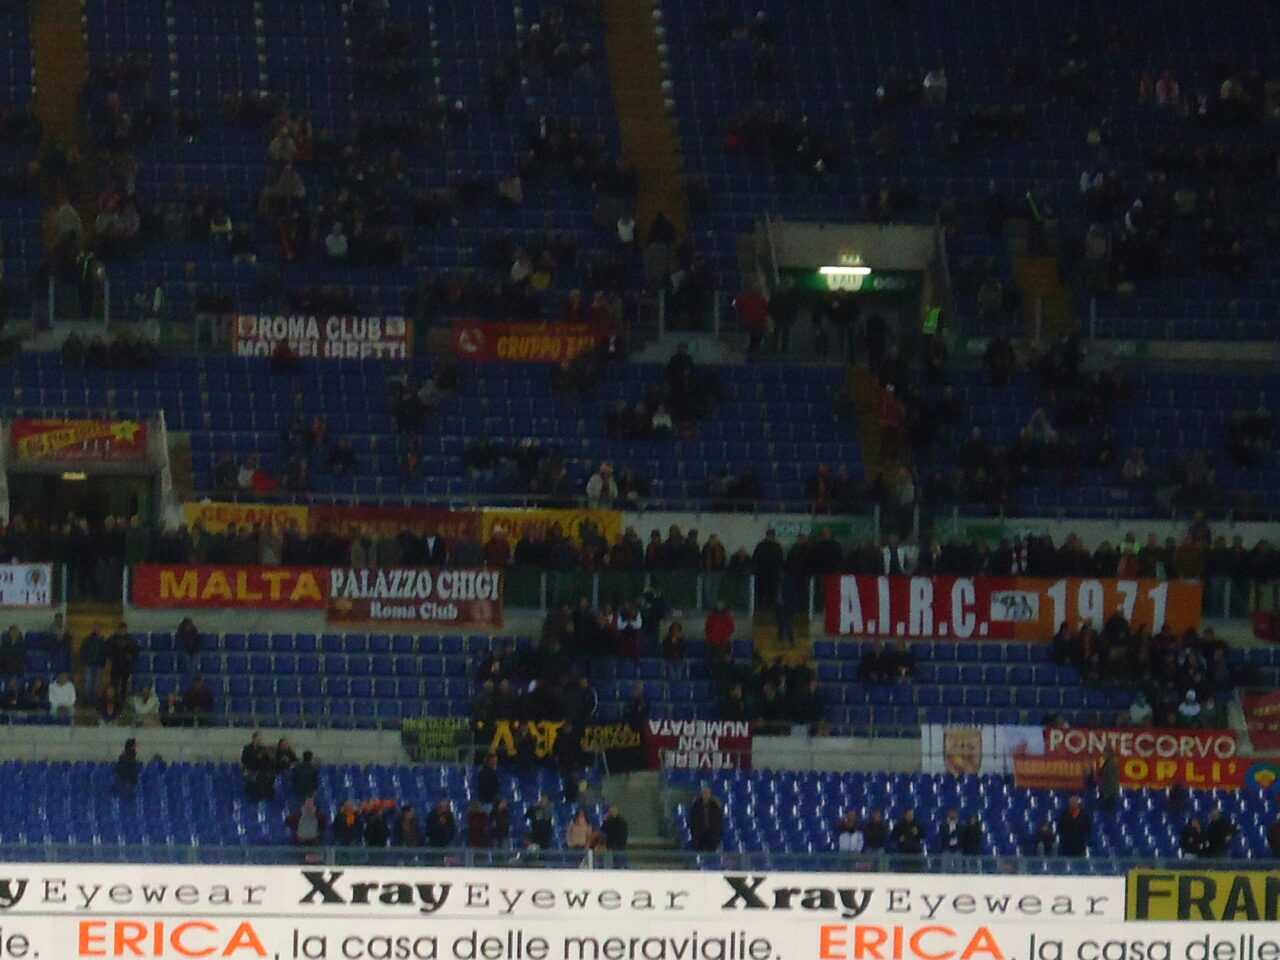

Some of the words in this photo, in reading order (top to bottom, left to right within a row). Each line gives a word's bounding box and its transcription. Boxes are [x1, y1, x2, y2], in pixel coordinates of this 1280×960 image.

[259, 315, 320, 340] ROMA
[326, 316, 382, 340] CLUB
[158, 569, 323, 601] MALTA
[330, 568, 433, 600] PALAZZO
[436, 569, 501, 600] CHIGI
[369, 601, 416, 620] Roma
[419, 601, 459, 620] Club
[839, 573, 990, 638] A.I.R.C.
[1047, 577, 1170, 636] 1971
[648, 719, 749, 738] NUMERATA
[678, 736, 720, 751] NON
[1049, 728, 1236, 759] PONTECORVO
[663, 750, 734, 769] TEVERE
[41, 879, 267, 910] Eyewear
[299, 870, 453, 912] Xray
[463, 882, 690, 913] Eyewear
[721, 875, 875, 919] Xray
[886, 887, 1110, 919] Eyewear
[292, 926, 327, 960] la
[340, 934, 438, 960] casa
